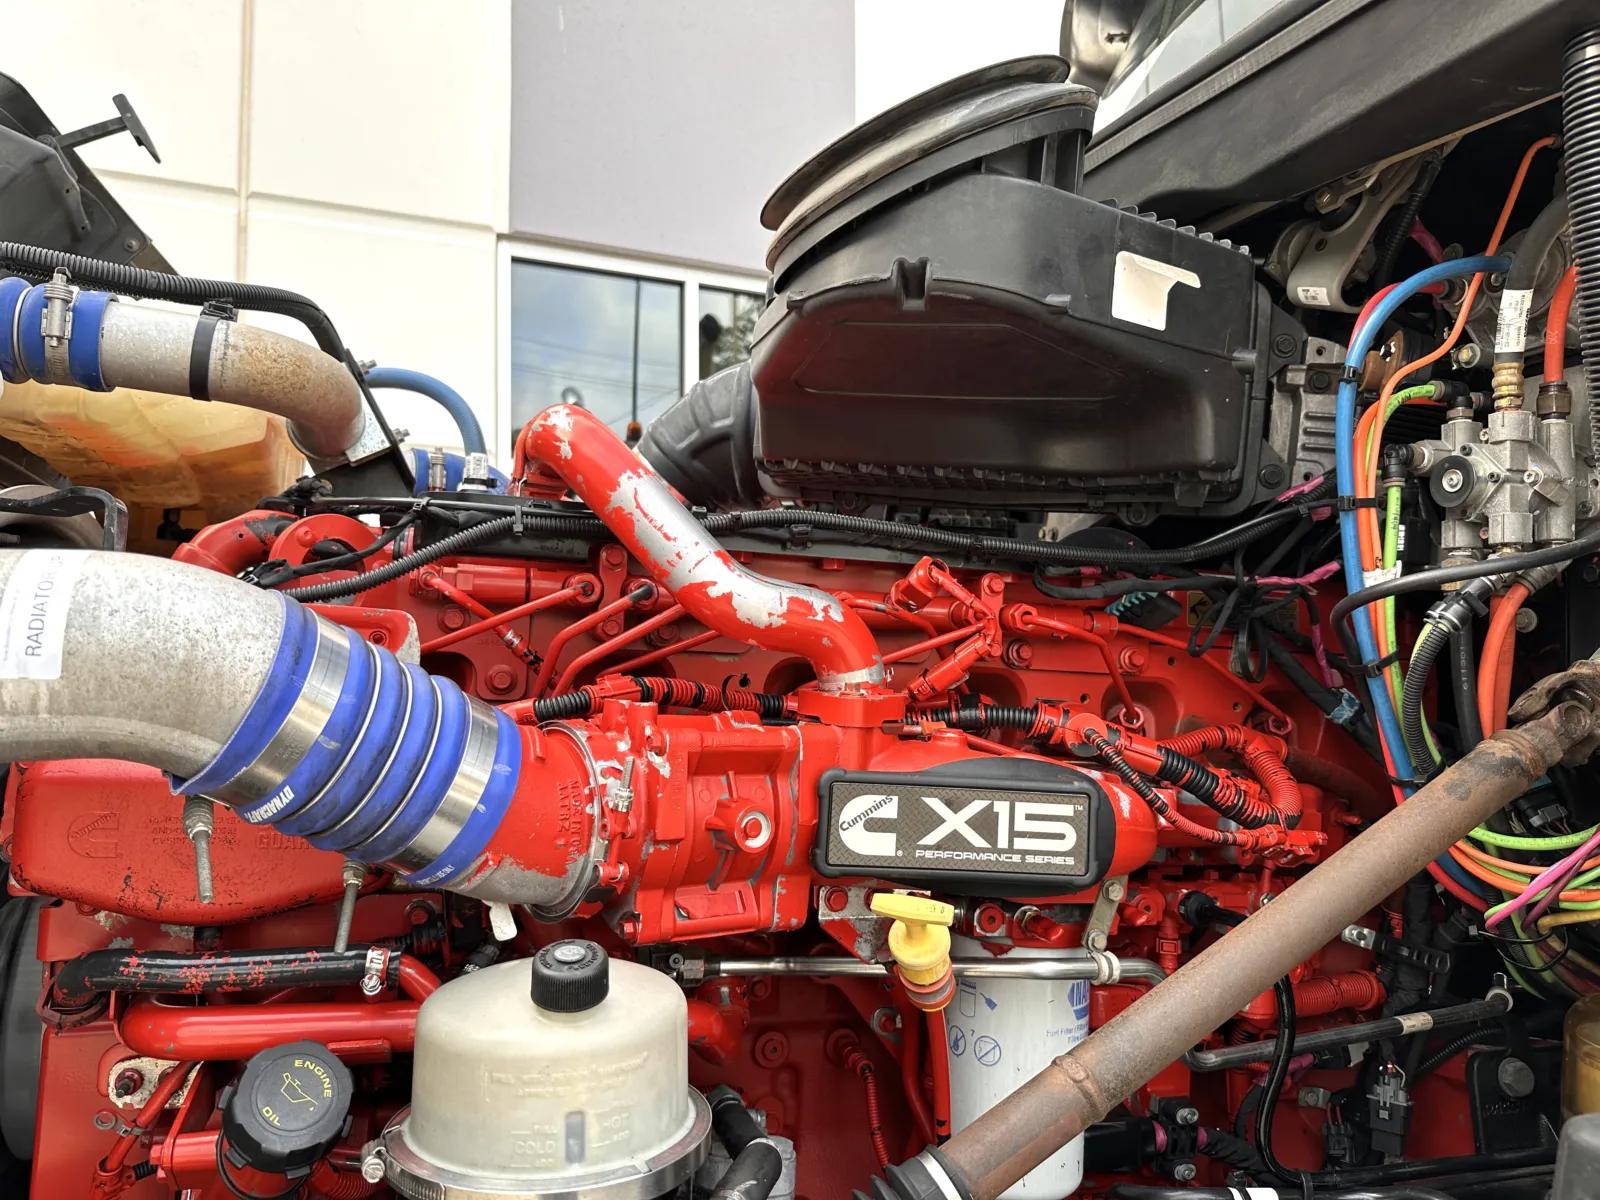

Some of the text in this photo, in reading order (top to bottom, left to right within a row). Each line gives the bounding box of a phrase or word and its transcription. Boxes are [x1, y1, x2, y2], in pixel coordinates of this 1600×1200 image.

[247, 785, 295, 824] DYNACRAFT
[839, 794, 893, 832] Cummins
[917, 797, 1077, 852] X15
[916, 850, 1075, 865] PERFORMANCE SERIES
[294, 1059, 333, 1098] ENGINE
[262, 1106, 281, 1126] OIL
[514, 1140, 556, 1154] COLD
